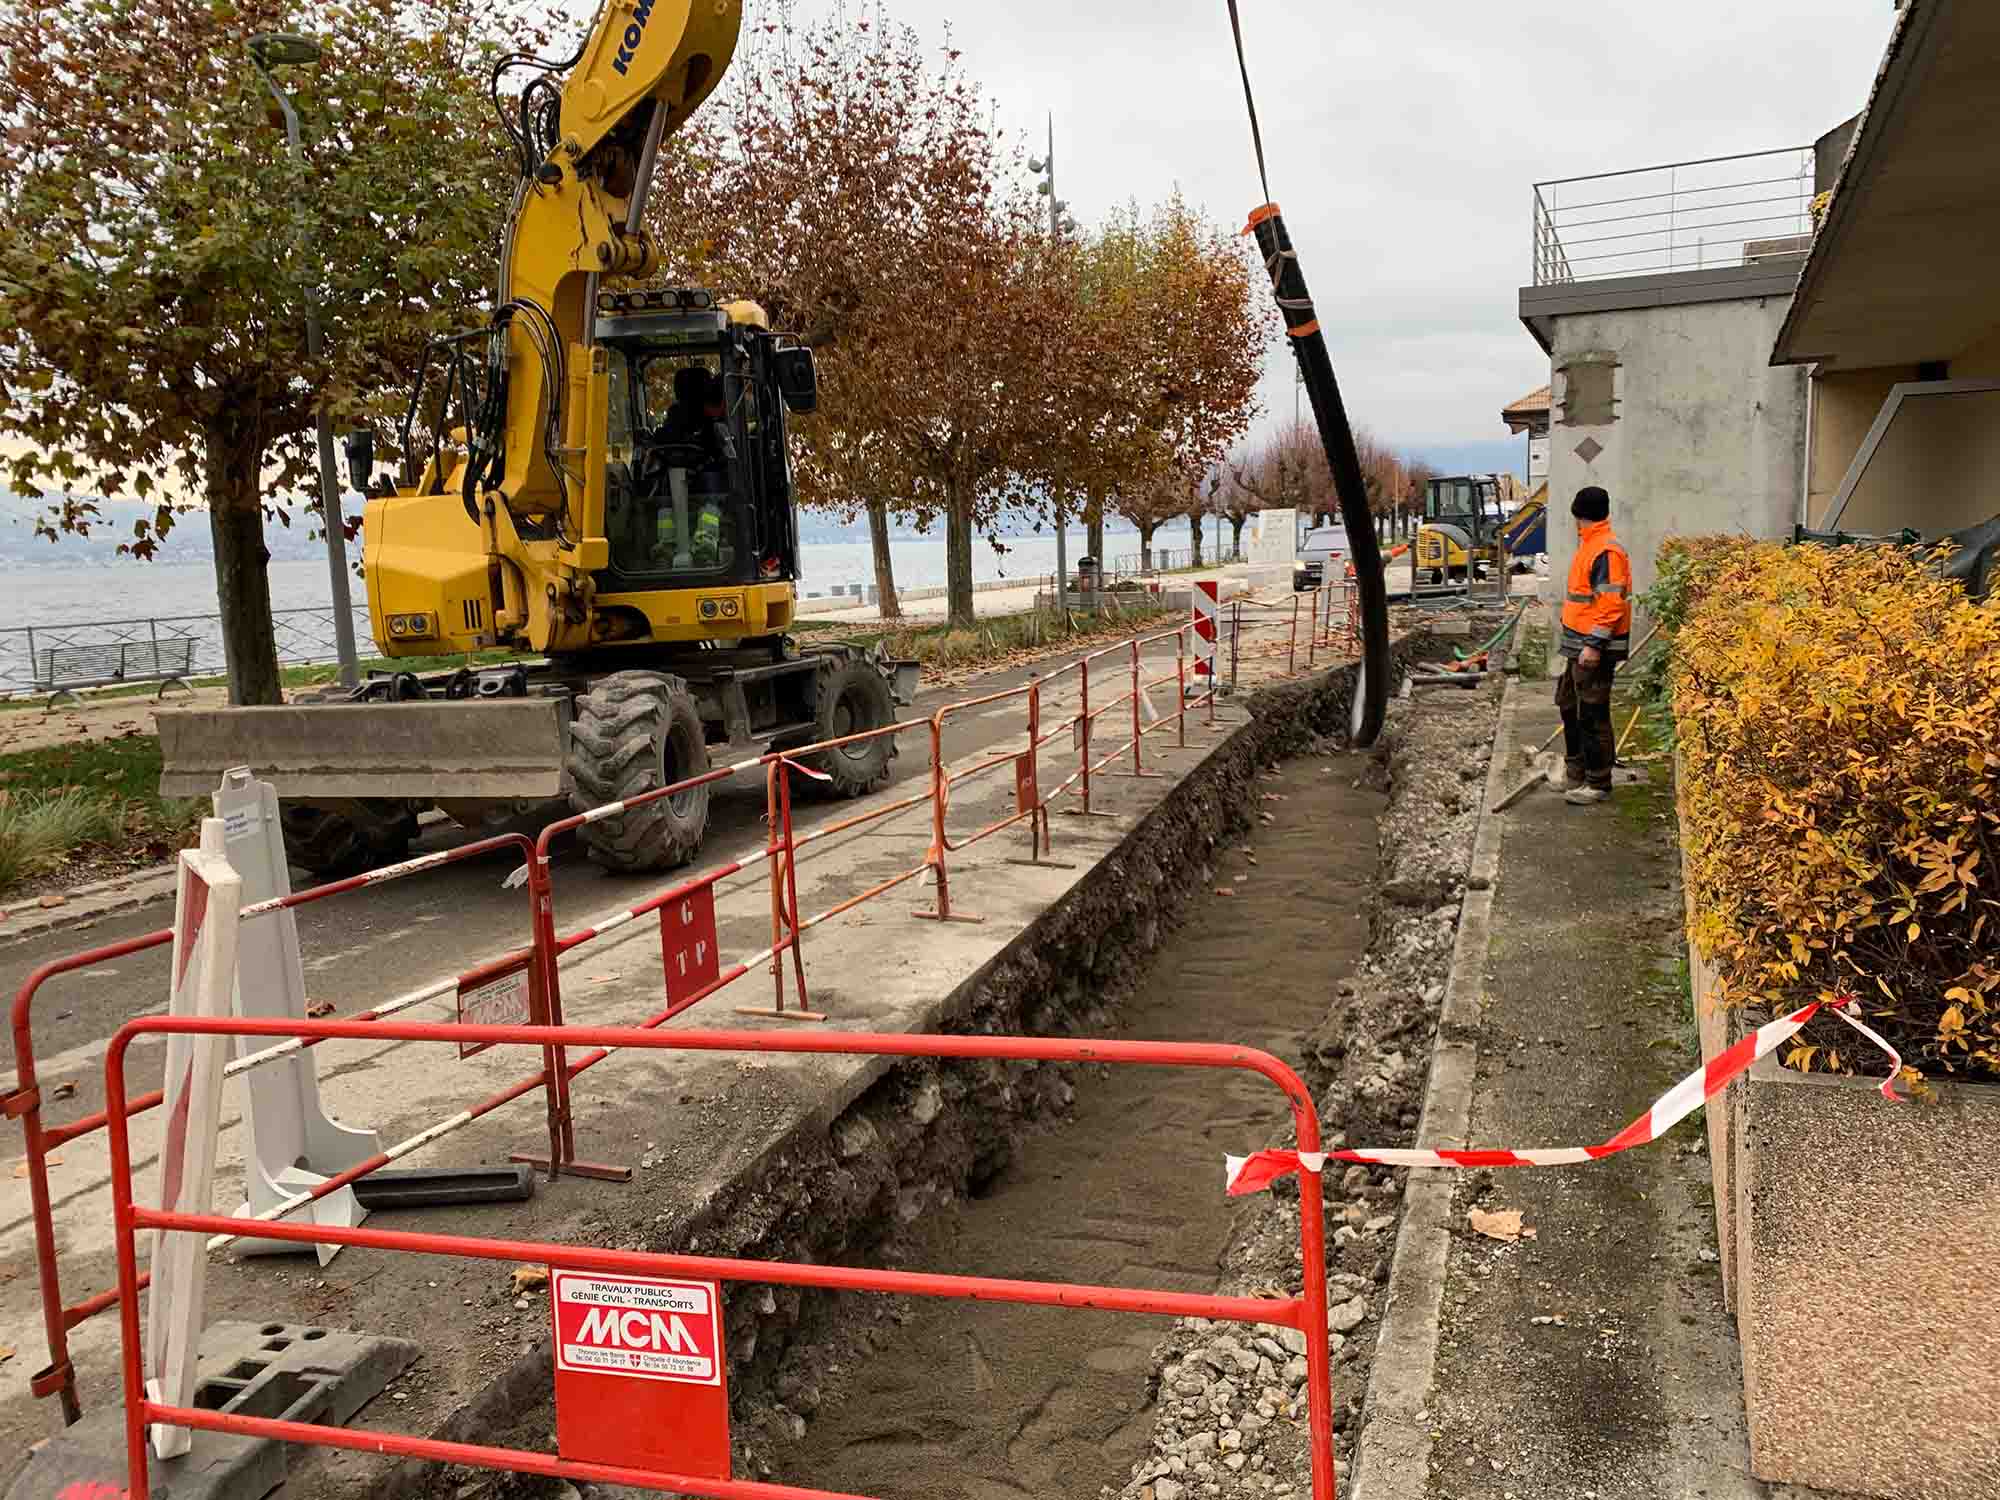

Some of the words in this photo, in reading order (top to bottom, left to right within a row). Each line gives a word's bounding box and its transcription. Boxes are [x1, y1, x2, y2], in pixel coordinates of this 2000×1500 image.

[590, 1283, 633, 1295] TRAVAUX
[634, 1287, 673, 1298] PUBLICS
[571, 1291, 599, 1302] GENIE
[601, 1294, 625, 1305] CIVIL
[633, 1296, 694, 1310] TRANSPORTS
[575, 1307, 701, 1354] MCM
